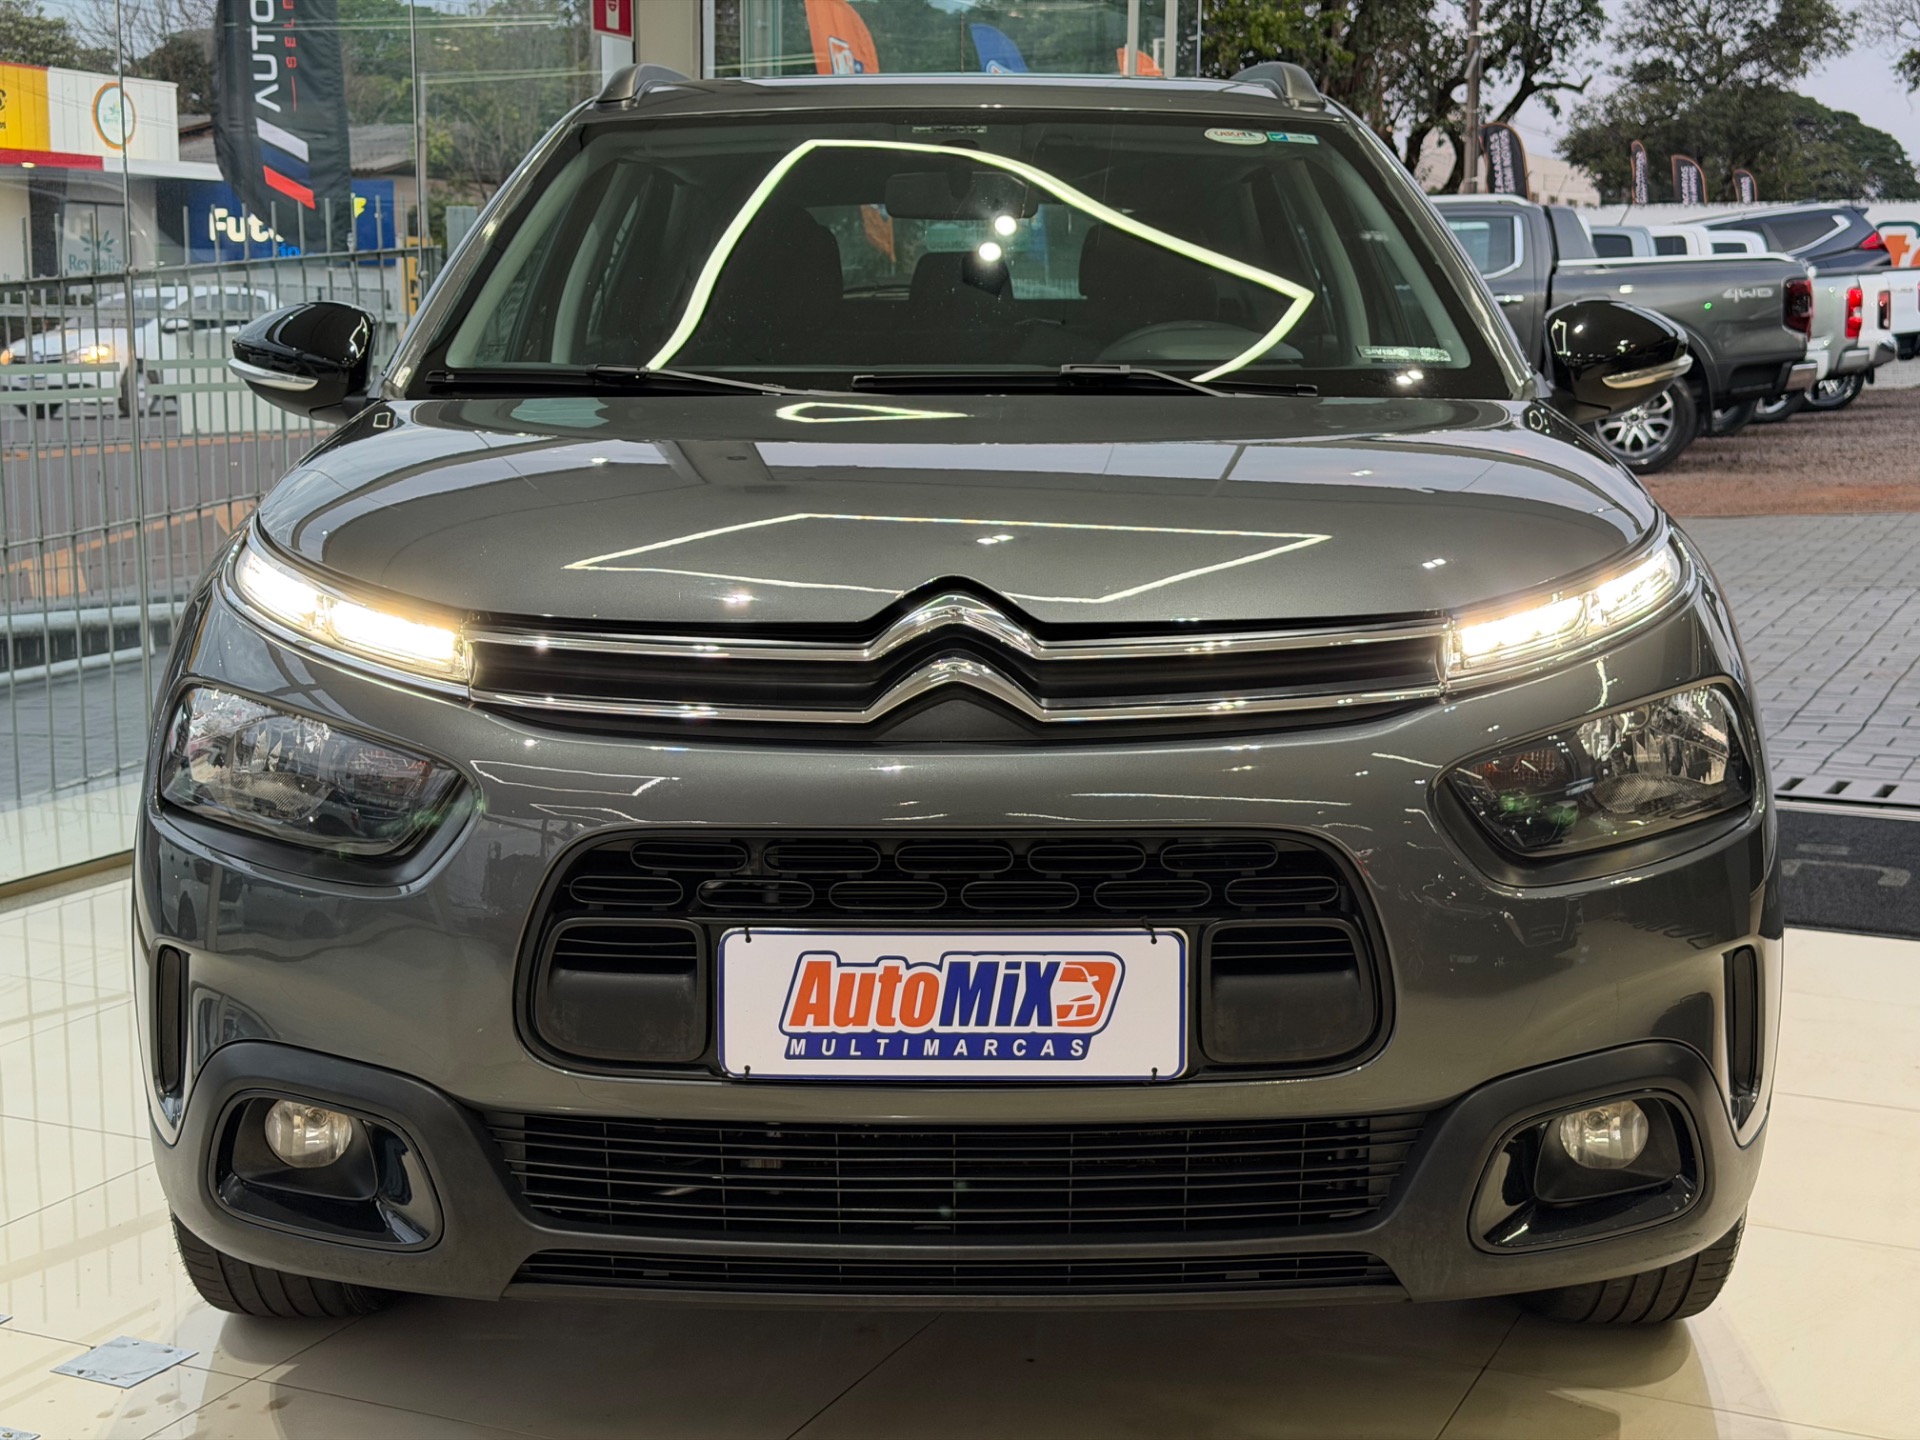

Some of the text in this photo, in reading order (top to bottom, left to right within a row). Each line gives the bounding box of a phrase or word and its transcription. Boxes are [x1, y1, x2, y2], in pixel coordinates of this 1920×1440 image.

[250, 0, 281, 113] AUTO
[1723, 287, 1774, 303] 4WD
[789, 1038, 1085, 1057] MULTIMARCAS
